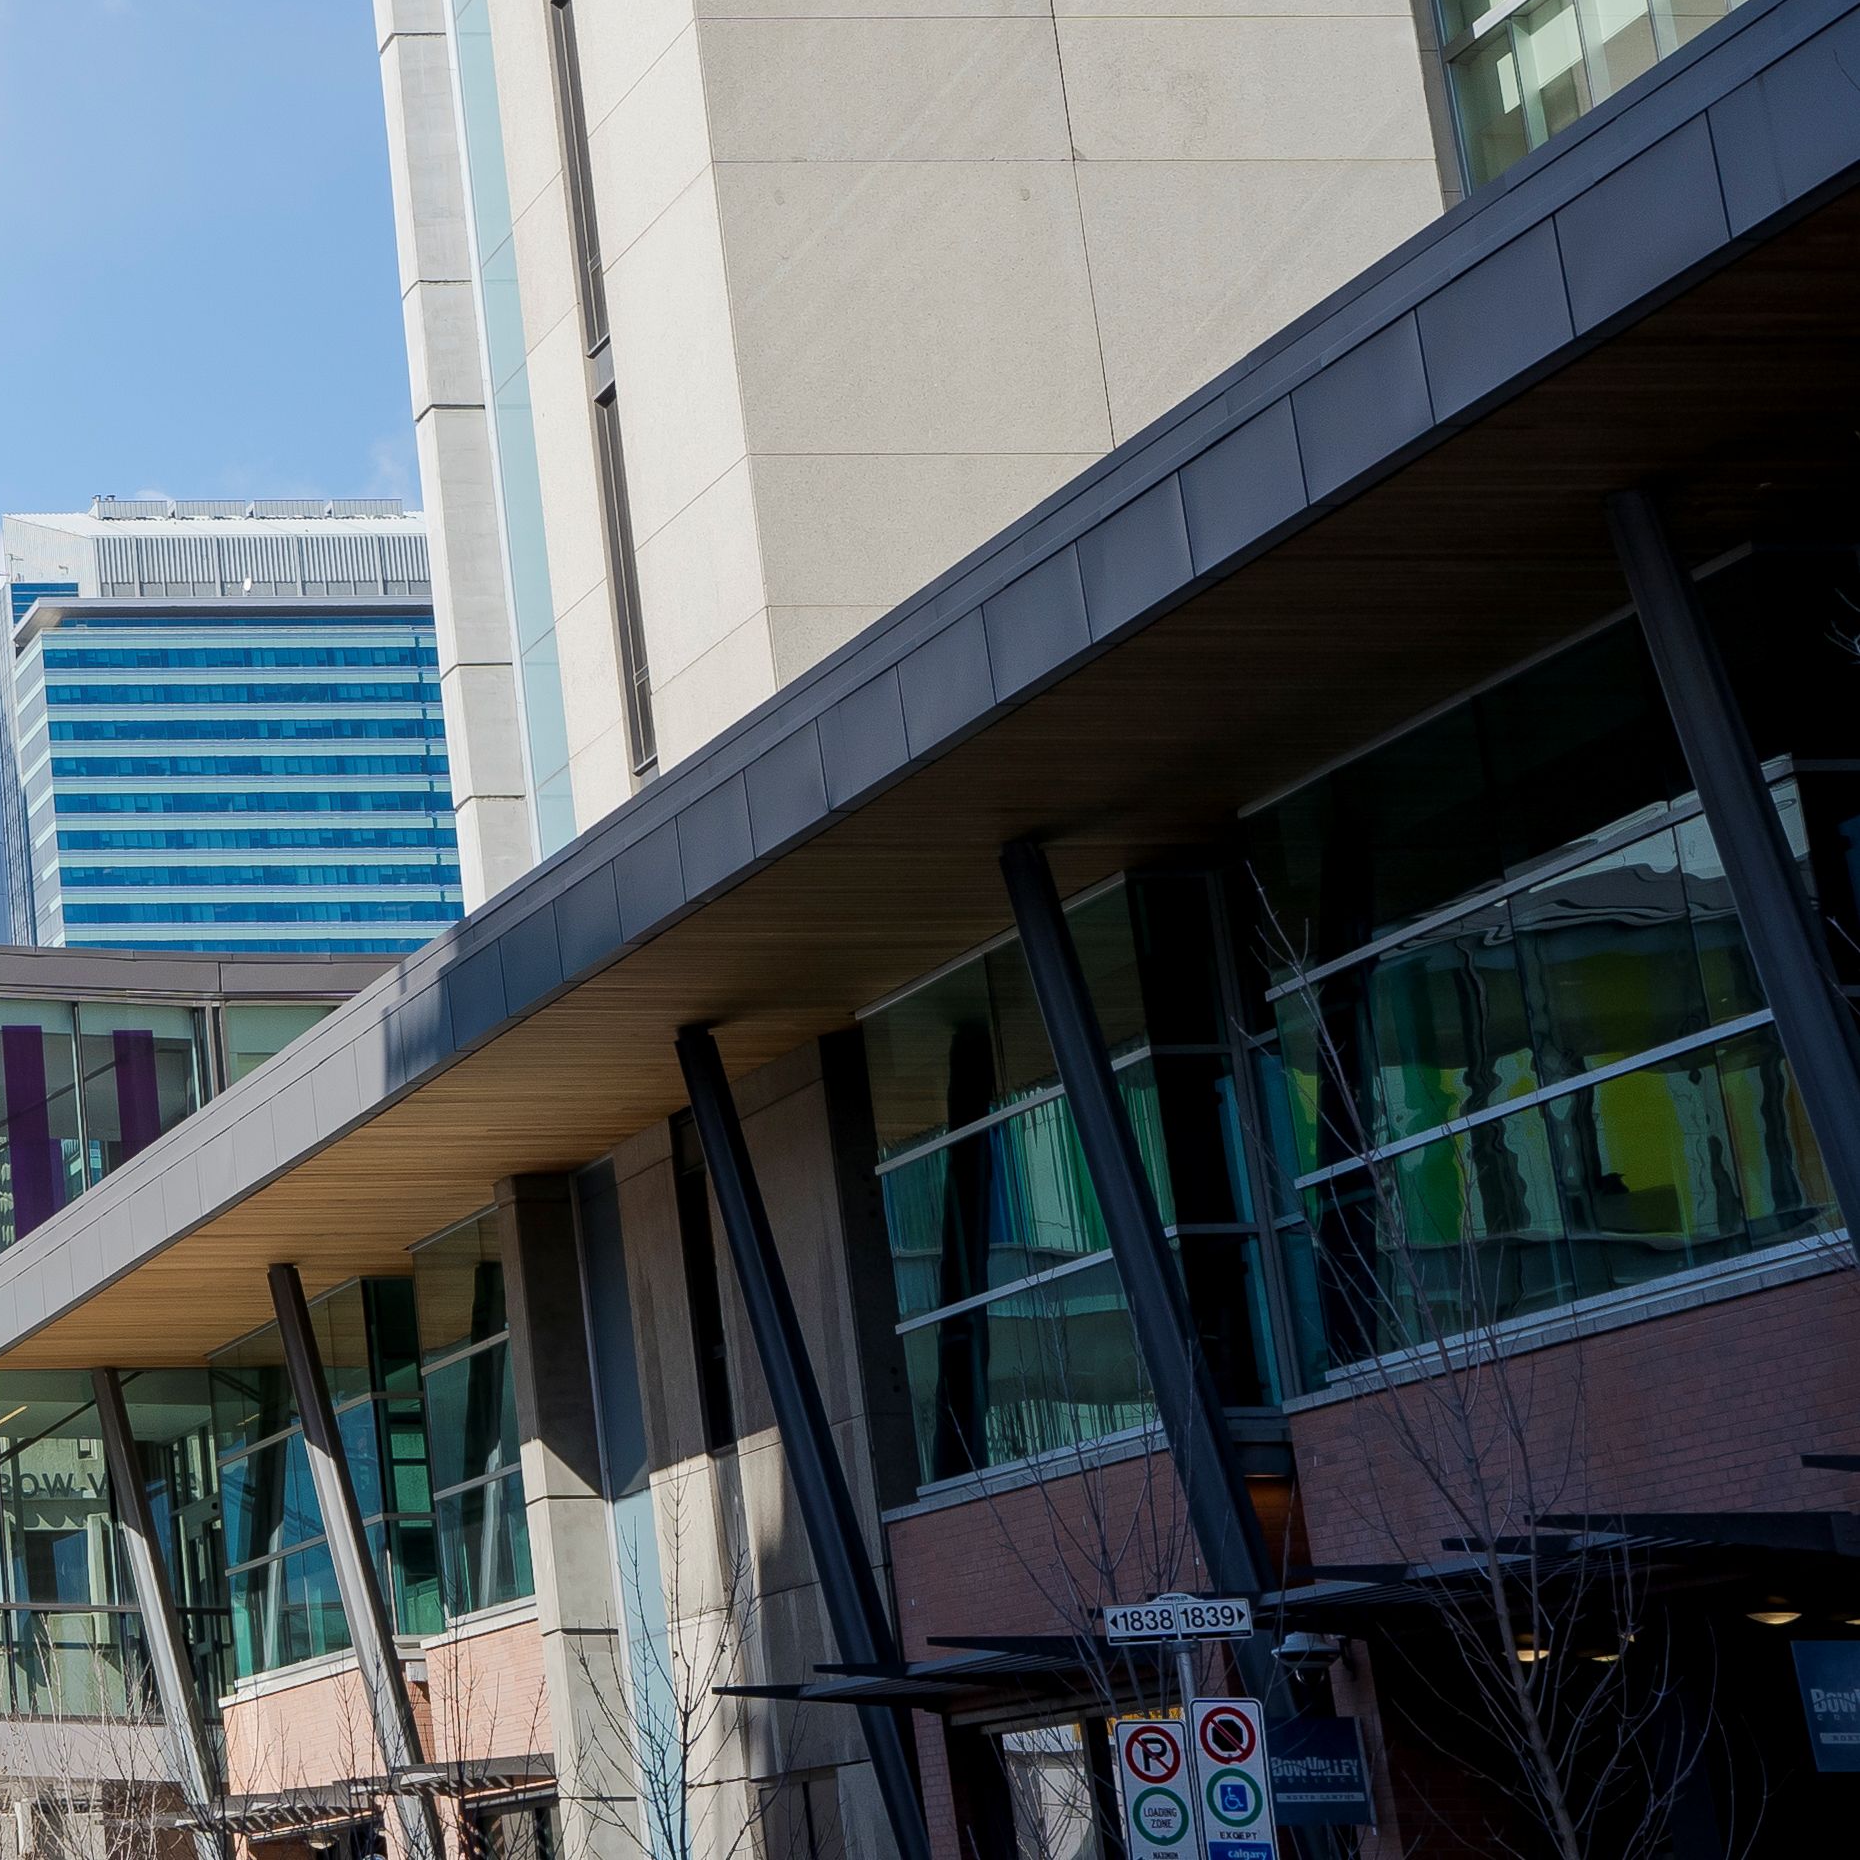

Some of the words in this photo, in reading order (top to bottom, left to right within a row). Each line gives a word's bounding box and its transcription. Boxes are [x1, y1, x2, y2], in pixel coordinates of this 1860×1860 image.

[0, 1473, 74, 1499] BOW
[1119, 1610, 1174, 1631] 1838
[1180, 1606, 1235, 1628] 1839
[1143, 1807, 1177, 1818] LOADING
[1151, 1819, 1173, 1828] ZONE
[1219, 1831, 1257, 1840] EXCEPT
[1228, 1848, 1267, 1860] calgary
